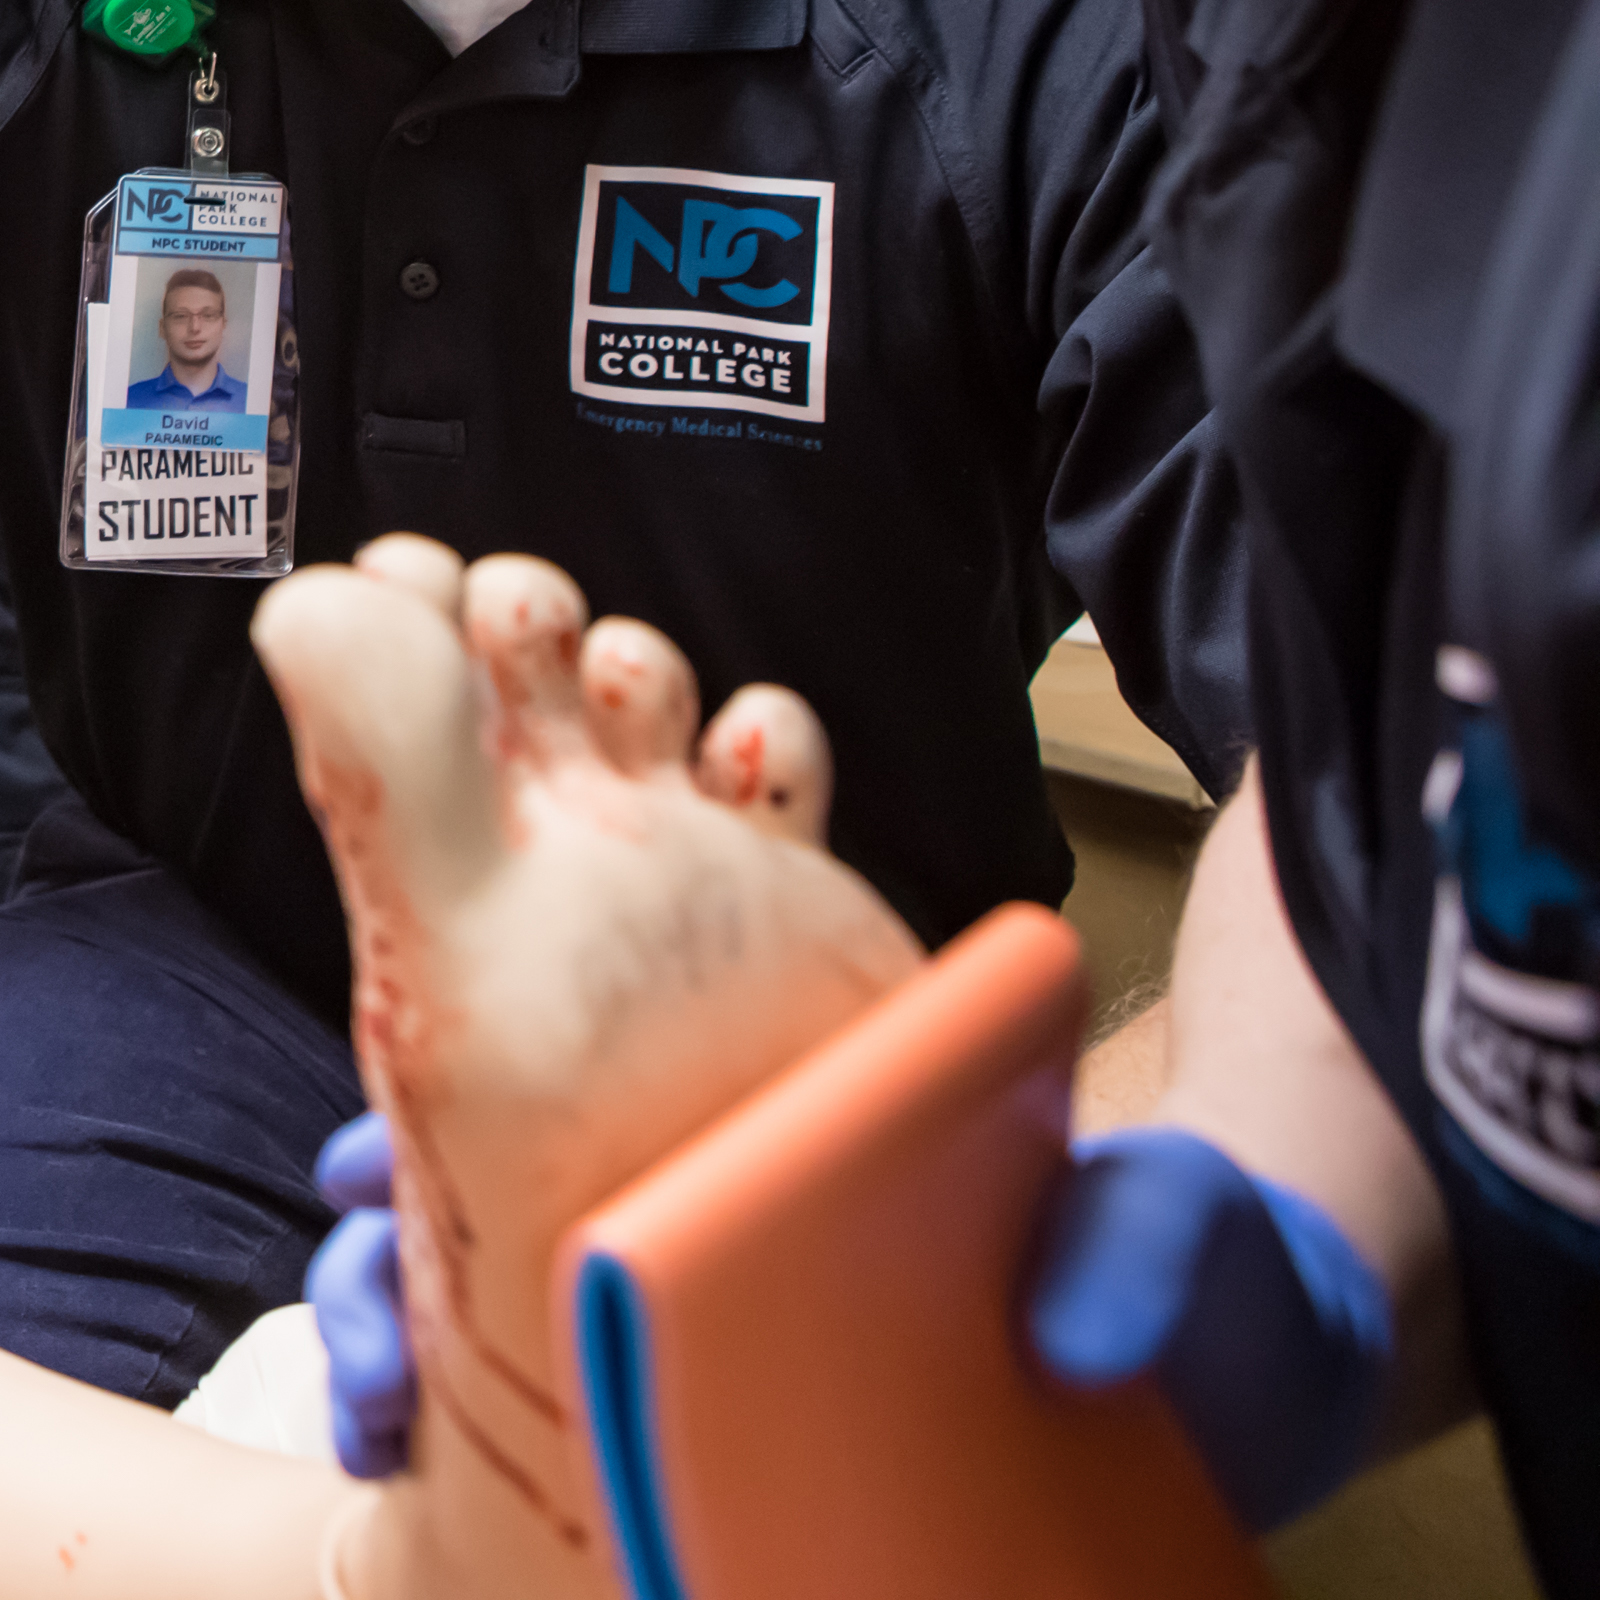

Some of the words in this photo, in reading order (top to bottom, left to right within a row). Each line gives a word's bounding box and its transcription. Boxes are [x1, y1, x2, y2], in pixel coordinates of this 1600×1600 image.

[125, 186, 186, 223] NPC
[199, 190, 278, 203] NATIONAL
[197, 214, 267, 227] COLLEGE
[152, 238, 181, 249] NPC
[184, 239, 246, 252] STUDENT
[608, 196, 804, 308] NPC
[599, 333, 724, 354] NATIONAL
[732, 342, 792, 365] PARK
[599, 351, 792, 393] COLLEGE
[145, 432, 224, 446] PARAMEDIC
[161, 414, 209, 431] David
[576, 401, 667, 437] Emergency
[671, 415, 743, 439] Medical
[747, 422, 823, 451] Sciences
[101, 449, 254, 482] PARAMEDIC
[98, 494, 259, 542] STUDENT
